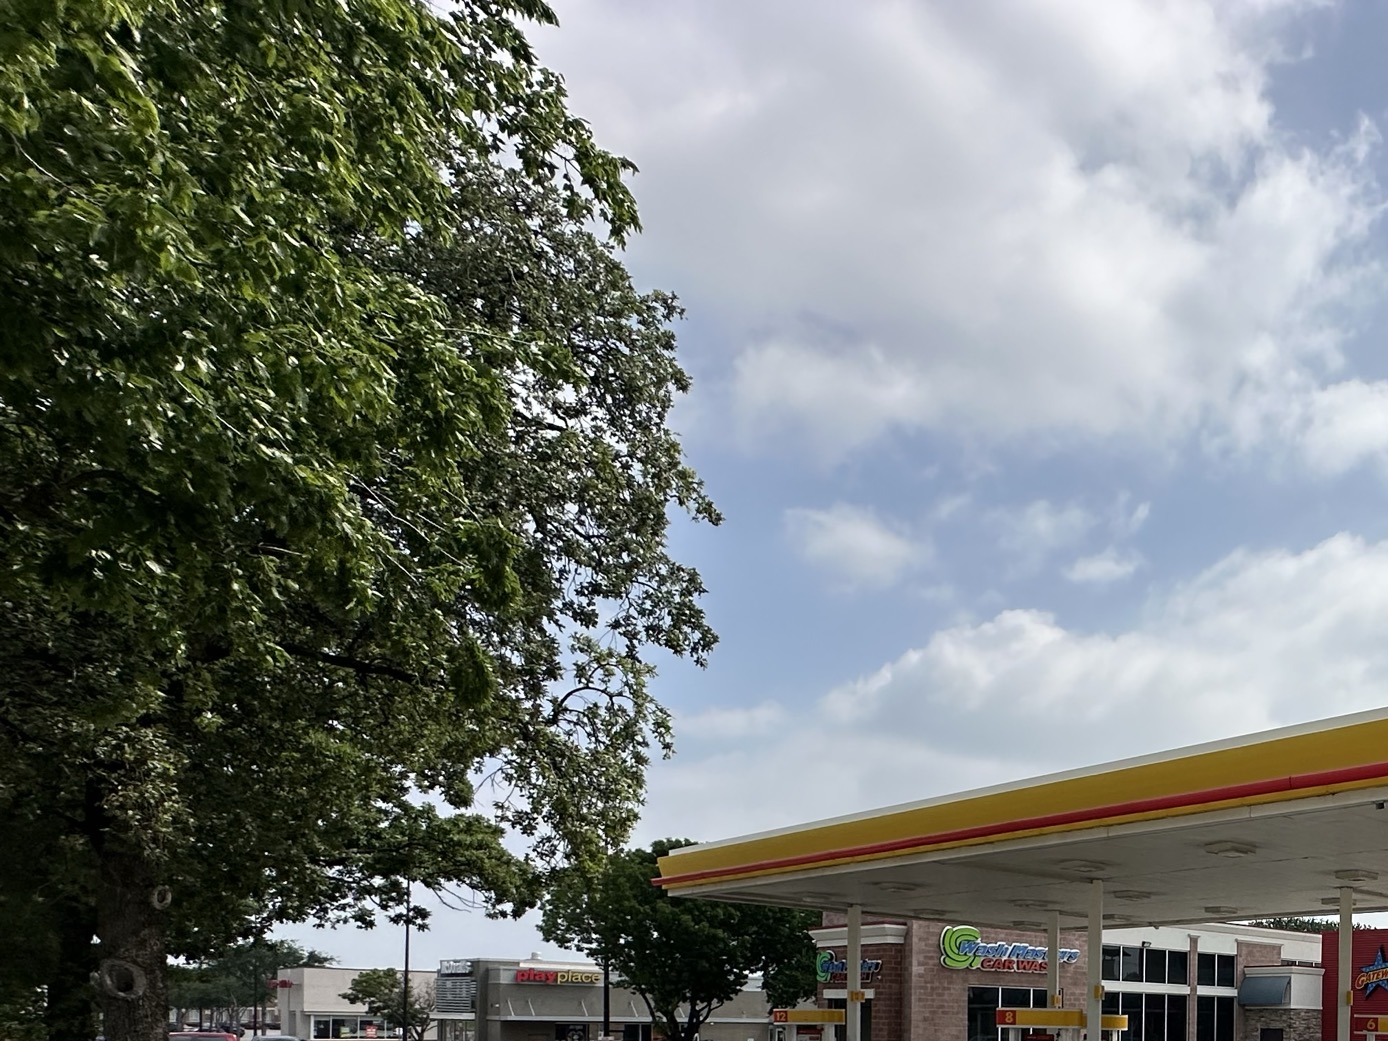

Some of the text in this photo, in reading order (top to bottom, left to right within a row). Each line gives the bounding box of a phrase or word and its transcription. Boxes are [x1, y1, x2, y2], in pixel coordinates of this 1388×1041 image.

[959, 940, 1009, 958] Wash
[981, 958, 1050, 972] CAR WAS
[776, 1012, 786, 1021] 12
[1005, 1012, 1013, 1023] 8
[1367, 1019, 1376, 1030] 6
